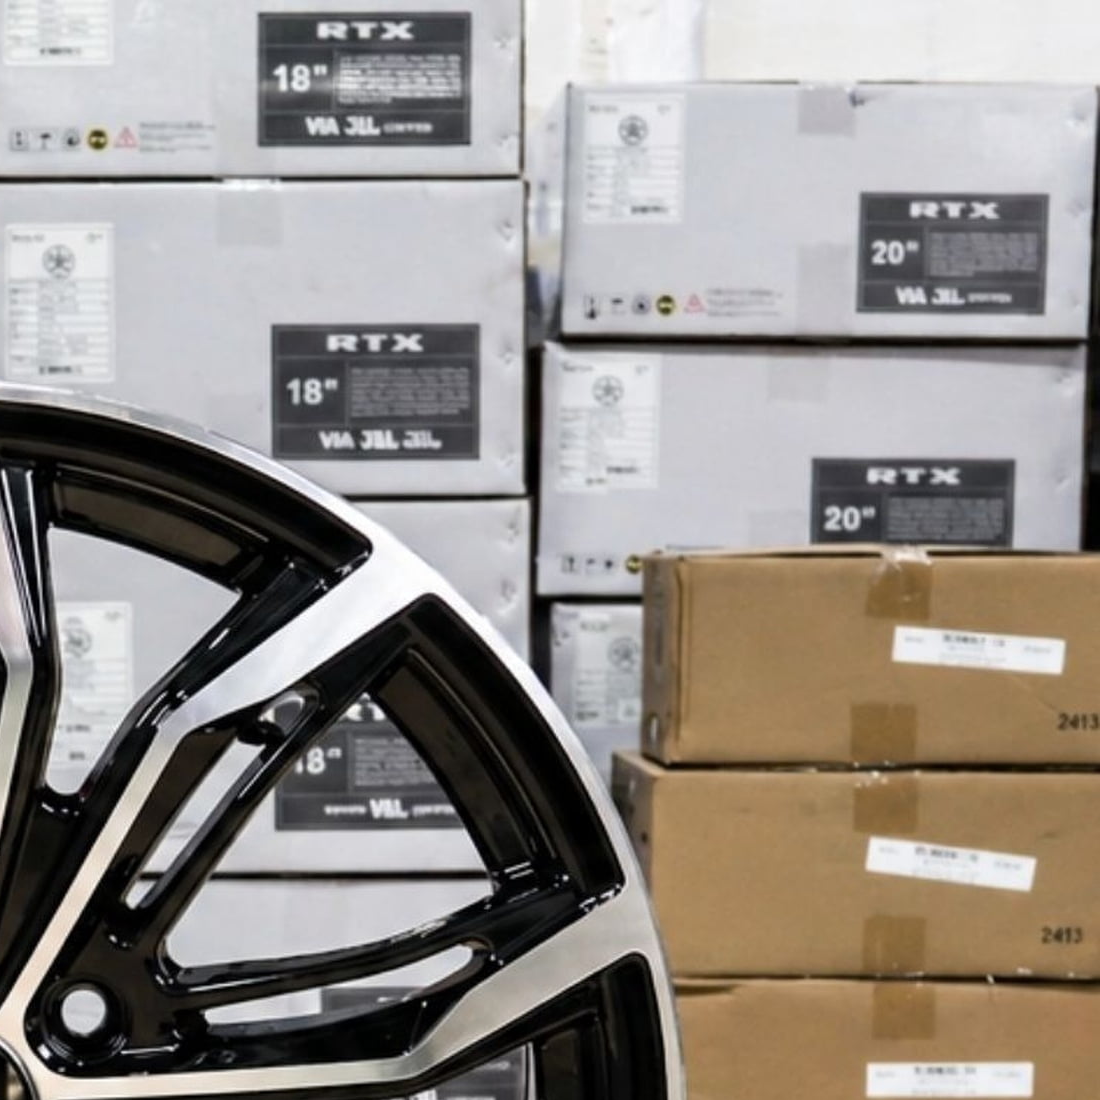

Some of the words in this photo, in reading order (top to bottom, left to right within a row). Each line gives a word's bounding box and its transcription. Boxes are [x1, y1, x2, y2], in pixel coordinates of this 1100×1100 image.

[316, 21, 414, 41] RTX
[272, 63, 328, 93] 18"
[909, 201, 999, 220] RTX
[871, 239, 919, 265] 20"
[326, 333, 424, 352] RTX
[286, 377, 338, 405] 18"
[866, 467, 960, 486] RTX
[824, 505, 876, 532] 20"
[1057, 712, 1100, 731] 2413
[1041, 926, 1083, 944] 2413
